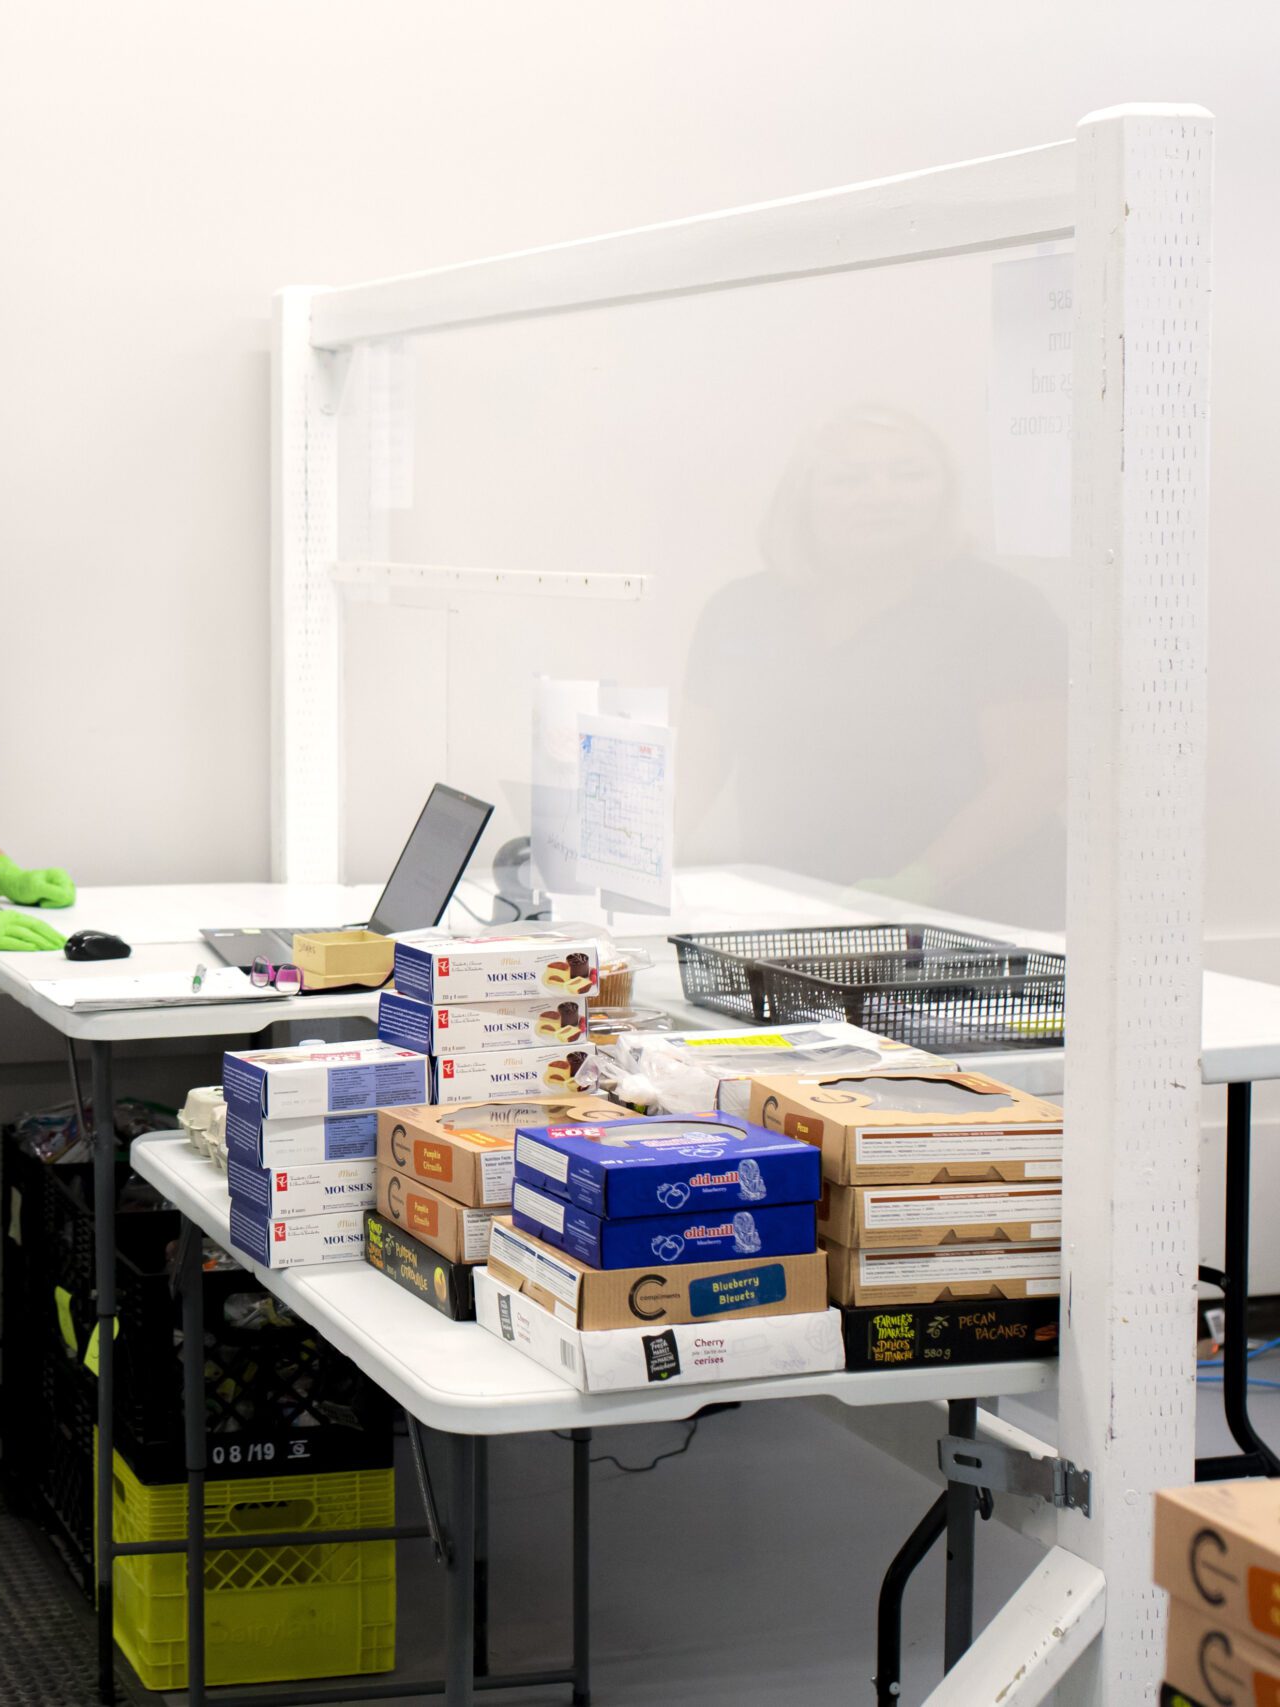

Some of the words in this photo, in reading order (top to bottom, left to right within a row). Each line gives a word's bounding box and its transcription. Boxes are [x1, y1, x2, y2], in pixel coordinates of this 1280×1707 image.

[487, 971, 536, 983] MOUSSES
[483, 1021, 530, 1033] MOUSSES
[490, 1071, 538, 1083] MOUSSES
[690, 1173, 711, 1187] old
[713, 1171, 739, 1185] mill
[324, 1183, 373, 1195] MOUSSES
[684, 1226, 705, 1239] old
[707, 1223, 734, 1237] mill
[712, 1275, 760, 1294] Blueberry
[639, 1292, 681, 1302] compliments
[719, 1290, 755, 1305] Bleuets
[958, 1311, 996, 1329] PECAN
[975, 1324, 1028, 1341] PACANES
[694, 1338, 725, 1348] Cherry
[924, 1348, 943, 1359] 580
[943, 1348, 951, 1360] g
[694, 1356, 725, 1366] cerises
